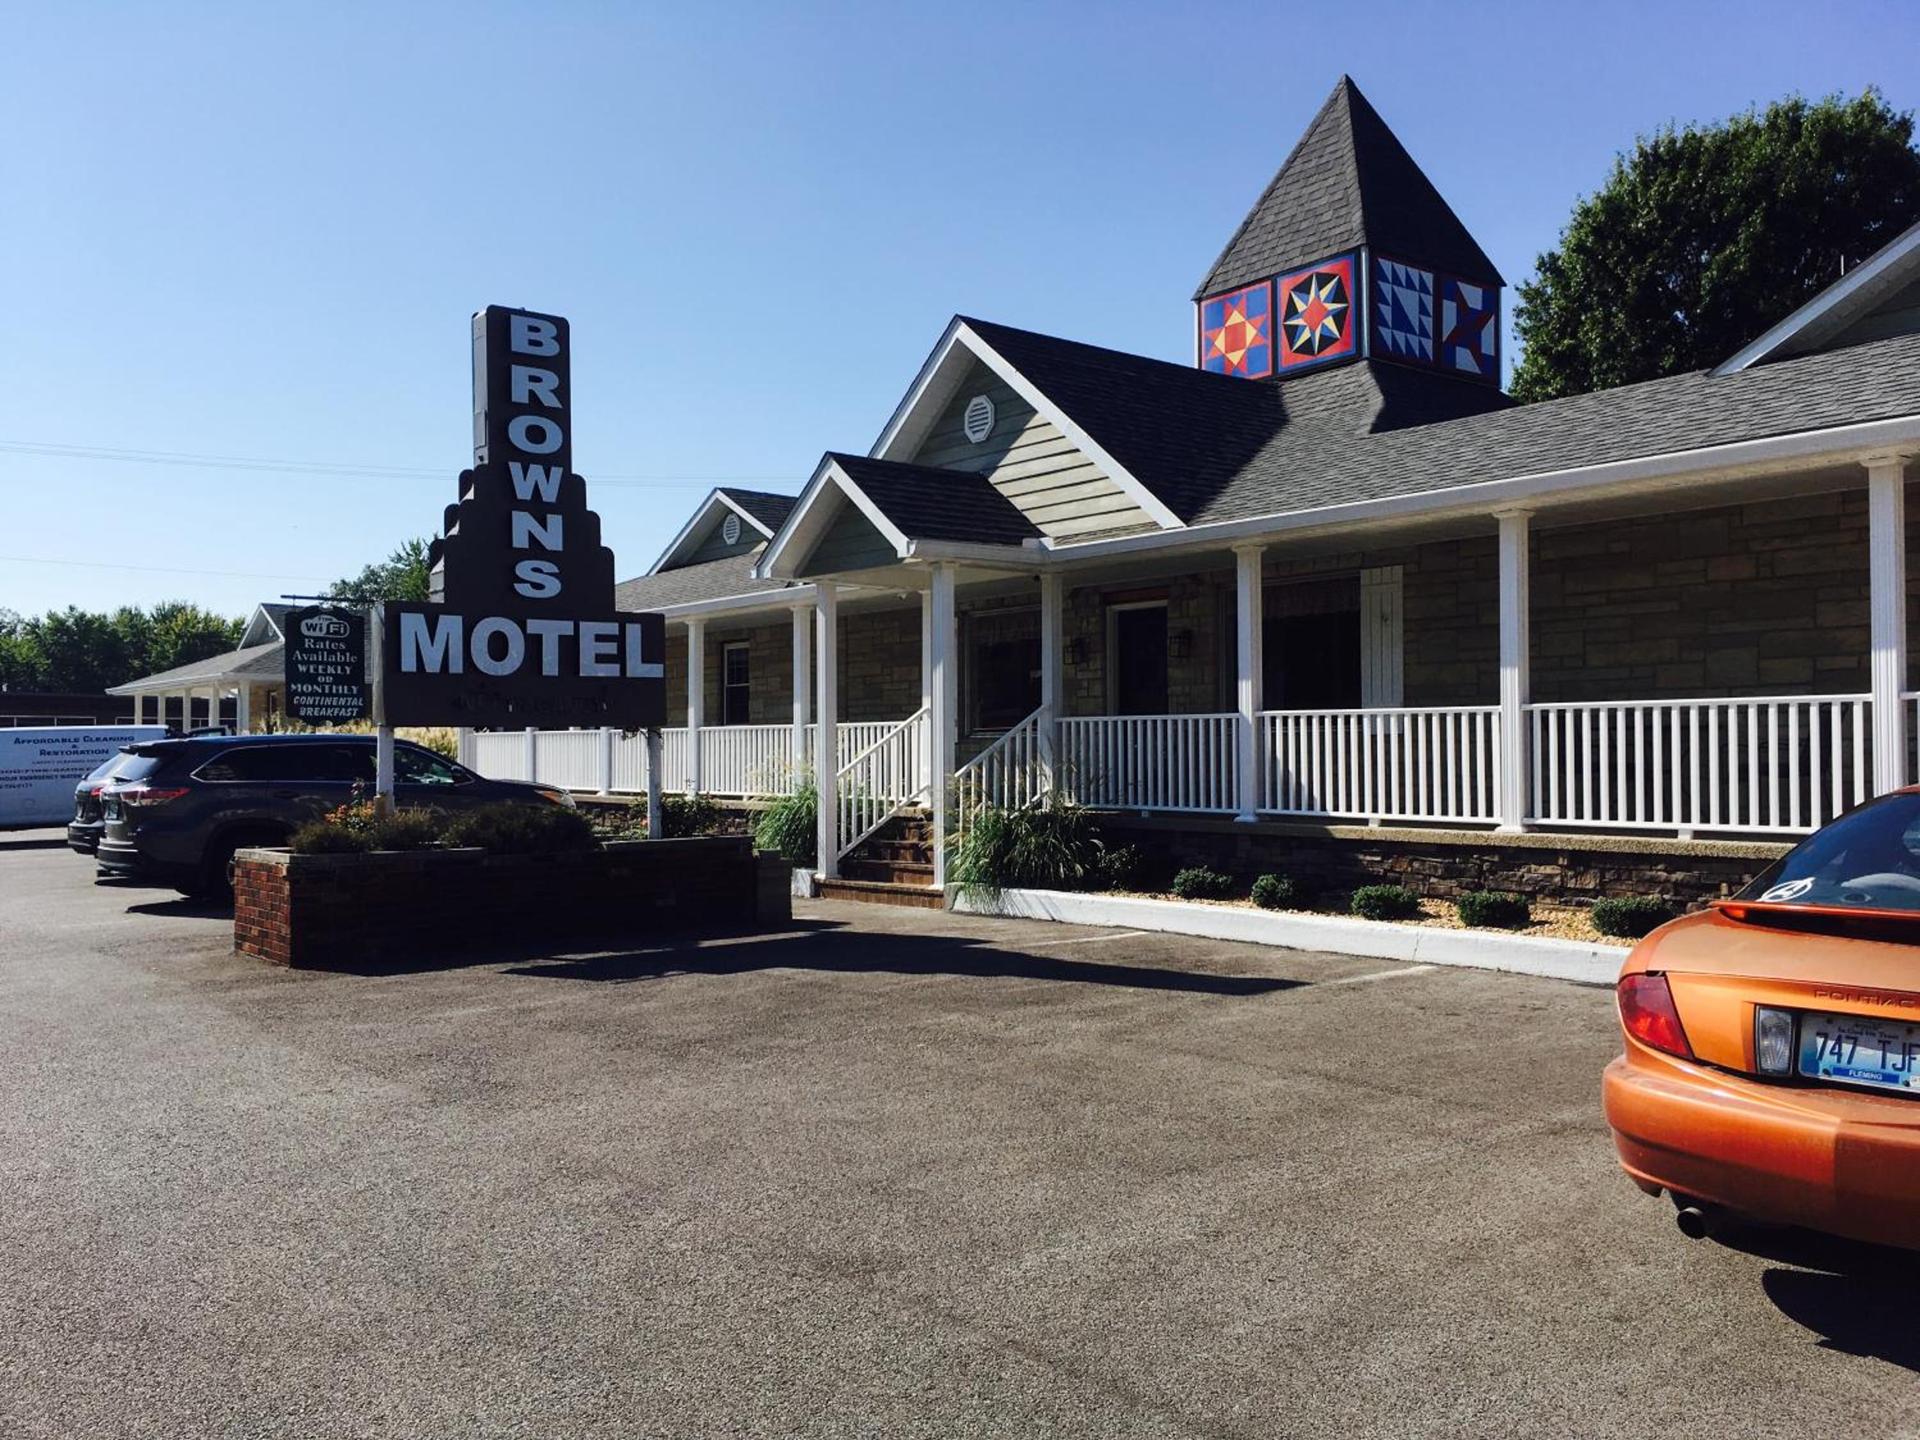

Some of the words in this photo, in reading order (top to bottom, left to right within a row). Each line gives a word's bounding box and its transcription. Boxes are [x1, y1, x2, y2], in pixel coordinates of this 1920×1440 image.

[508, 314, 563, 598] BROWNS
[304, 638, 346, 650] Rates
[400, 612, 664, 678] MOTEL
[292, 650, 358, 663] Available
[297, 664, 353, 675] WEEKLY
[290, 683, 360, 695] MONTHLY
[293, 696, 364, 706] CONTINENTAL
[299, 707, 359, 716] BREAKFAST
[1816, 1032, 1858, 1065] 747
[1877, 1039, 1920, 1073] TJF
[1849, 1069, 1883, 1080] FLEMING
